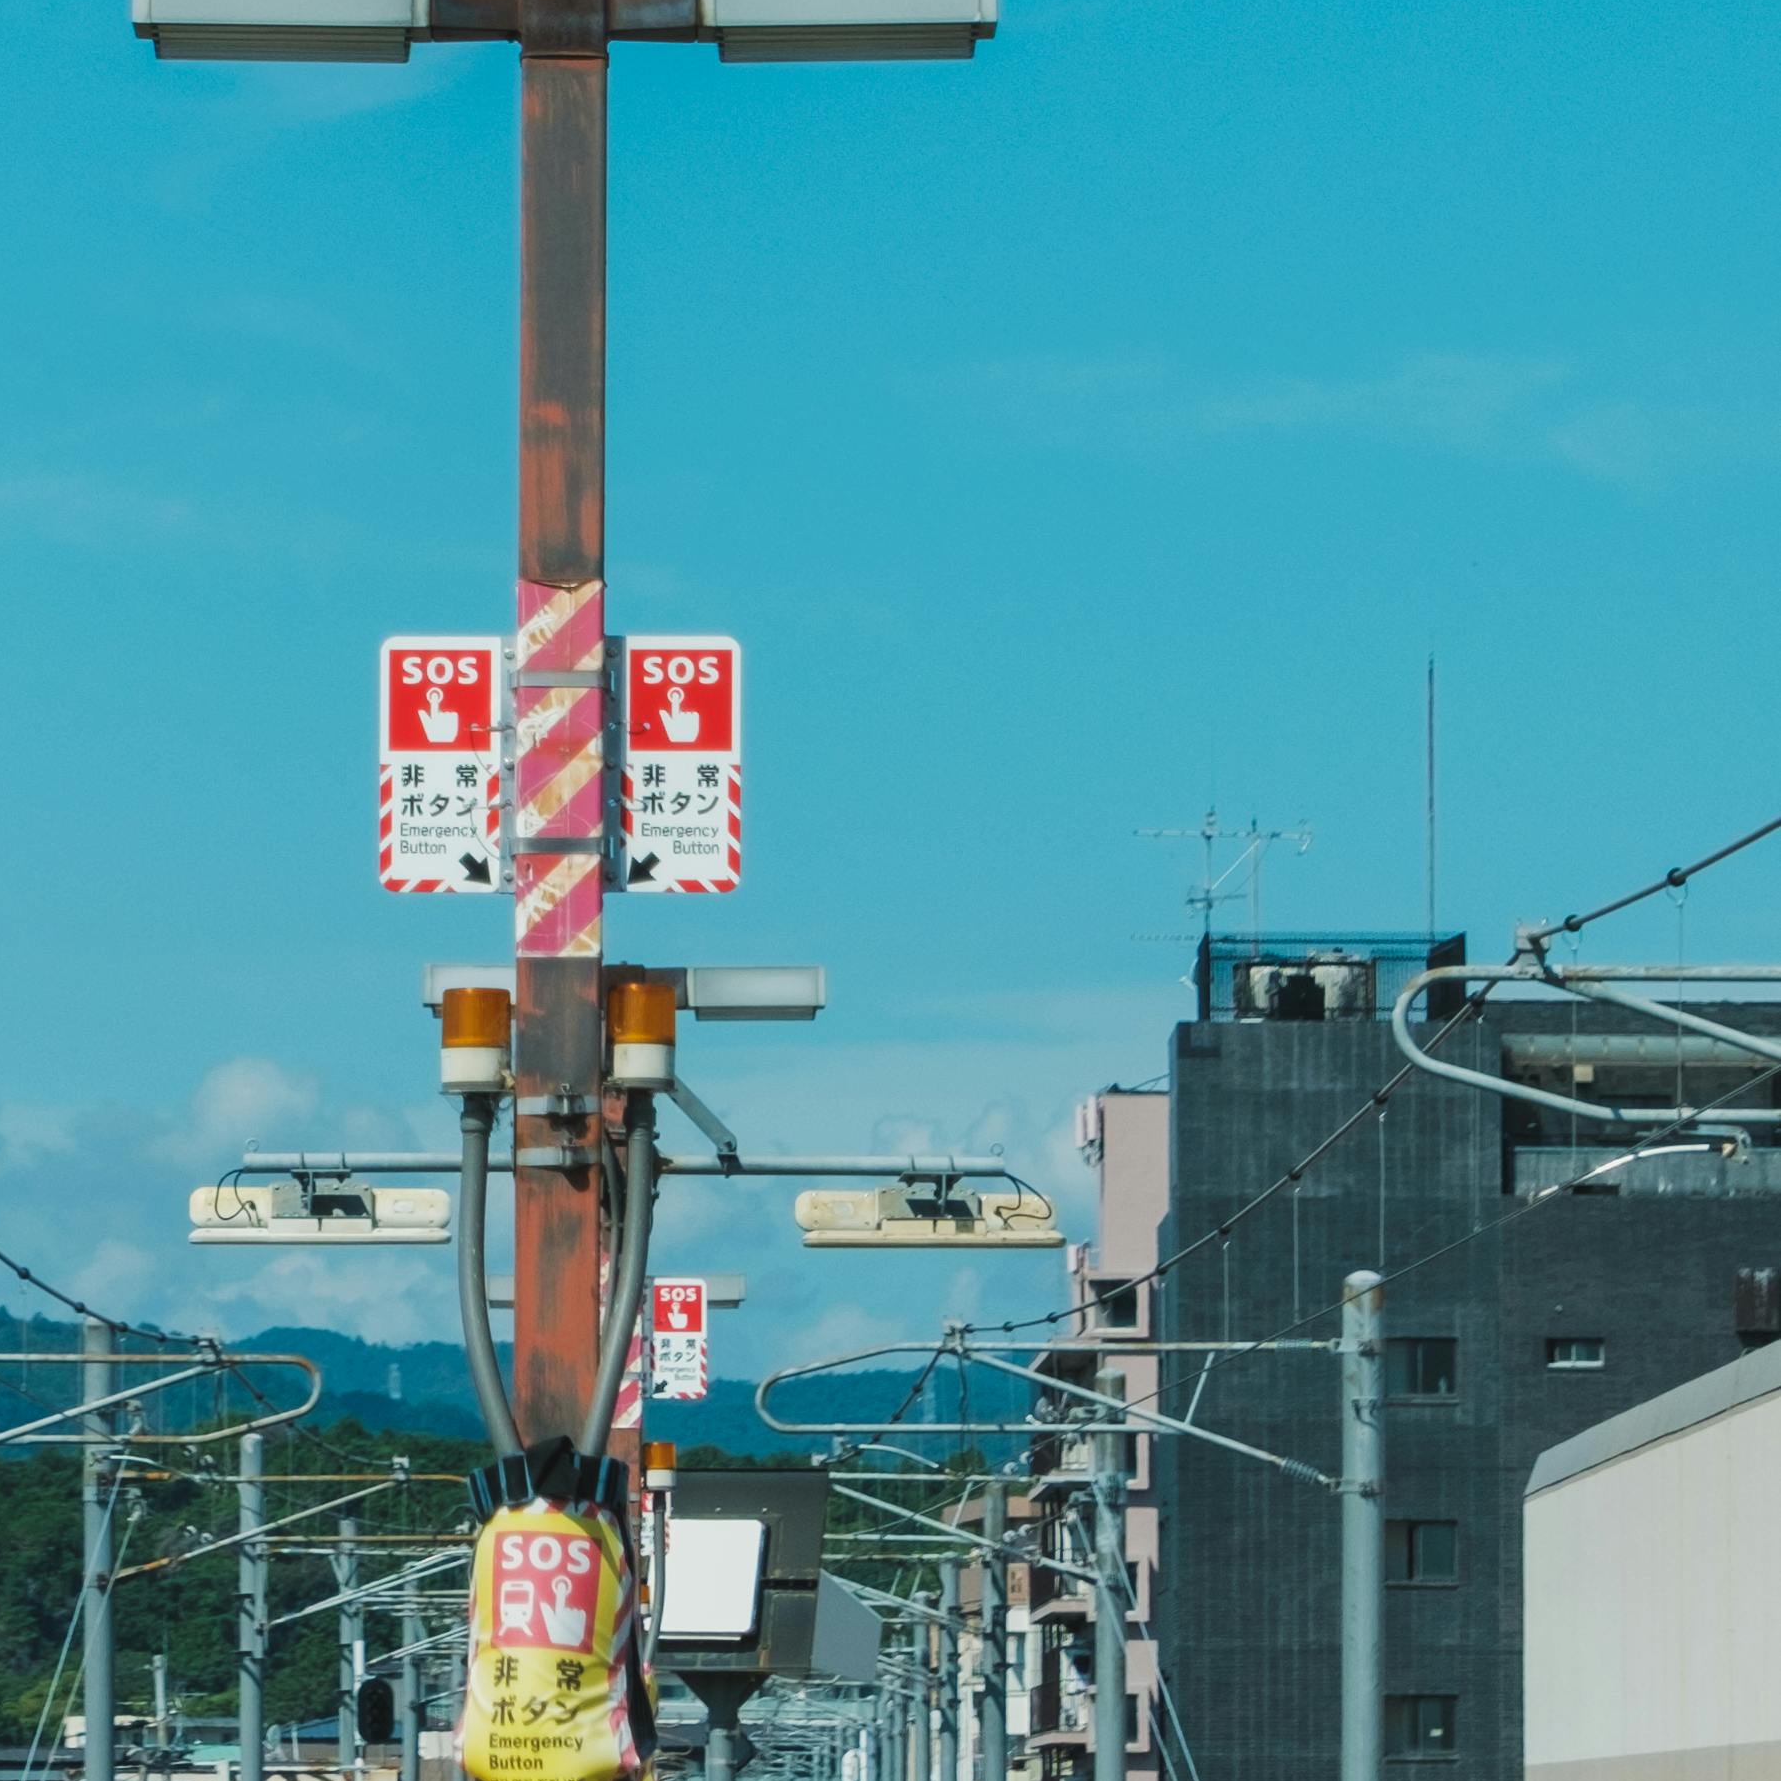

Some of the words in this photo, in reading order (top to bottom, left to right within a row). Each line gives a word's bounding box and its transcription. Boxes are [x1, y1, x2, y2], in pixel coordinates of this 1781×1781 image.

[401, 656, 479, 685] SOS
[642, 656, 720, 685] SOS
[401, 763, 479, 788] 非常
[641, 763, 720, 788] 非常
[401, 792, 479, 818] ボタン
[641, 791, 720, 816] ボタン
[399, 822, 478, 838] Emergency
[640, 822, 719, 838] Emergency
[399, 839, 448, 854] Button
[672, 839, 721, 855] Button
[660, 1288, 697, 1302] SOS
[500, 1534, 591, 1574] SOS
[493, 1655, 584, 1692] 非常
[491, 1695, 580, 1726] ボタン
[489, 1732, 583, 1752] Emergency
[489, 1754, 544, 1770] Button
